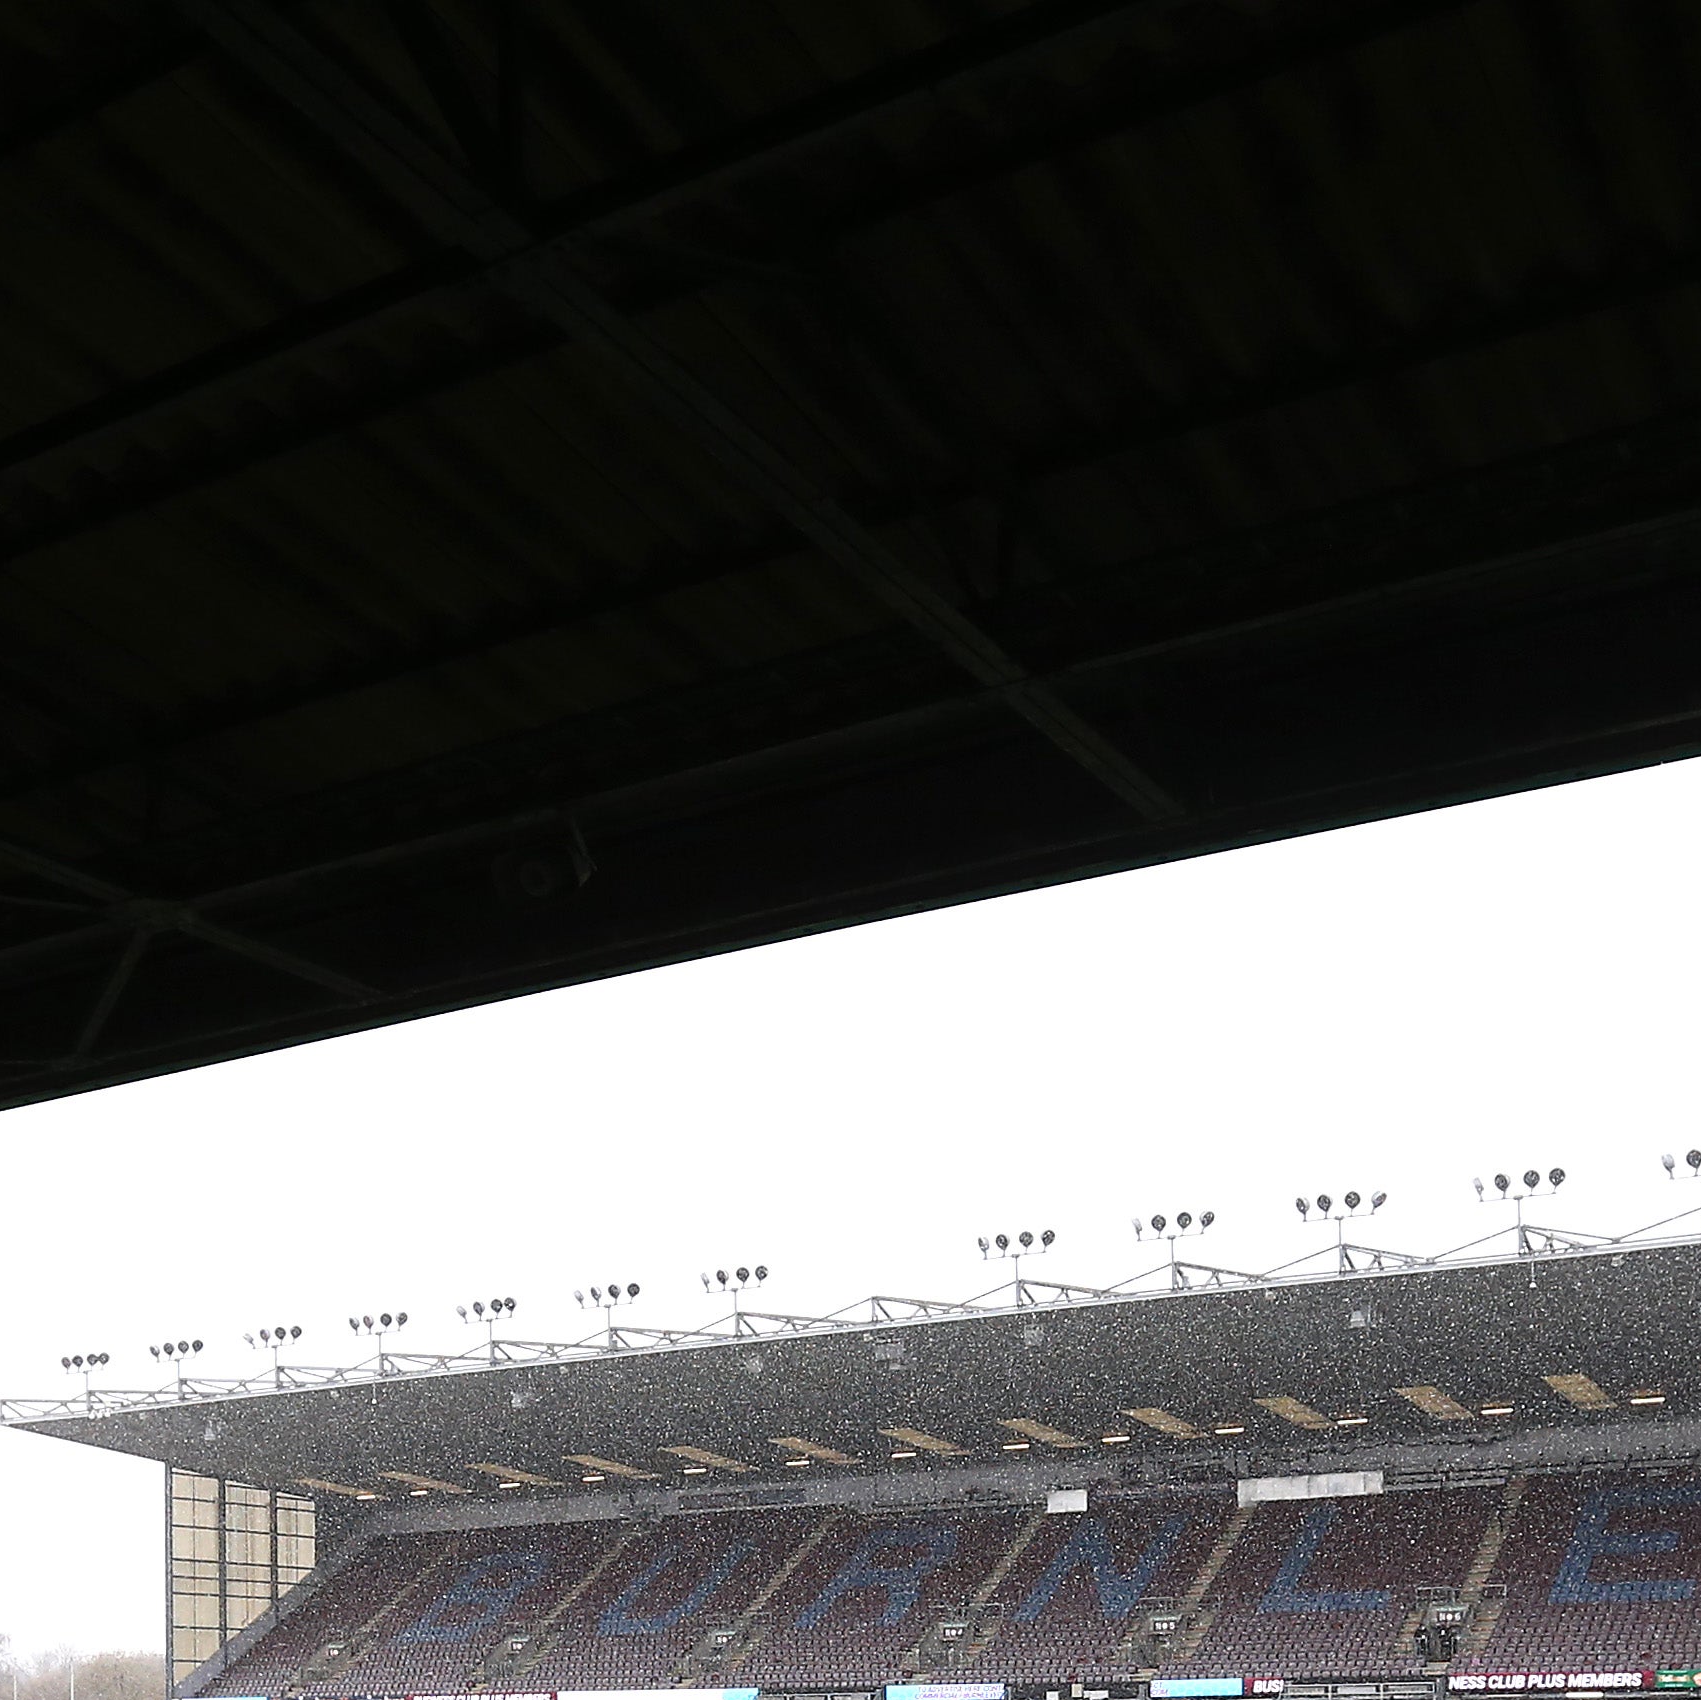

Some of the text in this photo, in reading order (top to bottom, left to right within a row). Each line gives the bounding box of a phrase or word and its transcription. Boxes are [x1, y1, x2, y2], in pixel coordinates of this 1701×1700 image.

[1448, 1676, 1486, 1690] NESS
[1488, 1675, 1525, 1689] CLUB
[1526, 1674, 1566, 1688] PLUS
[1568, 1672, 1643, 1688] MEMBERS
